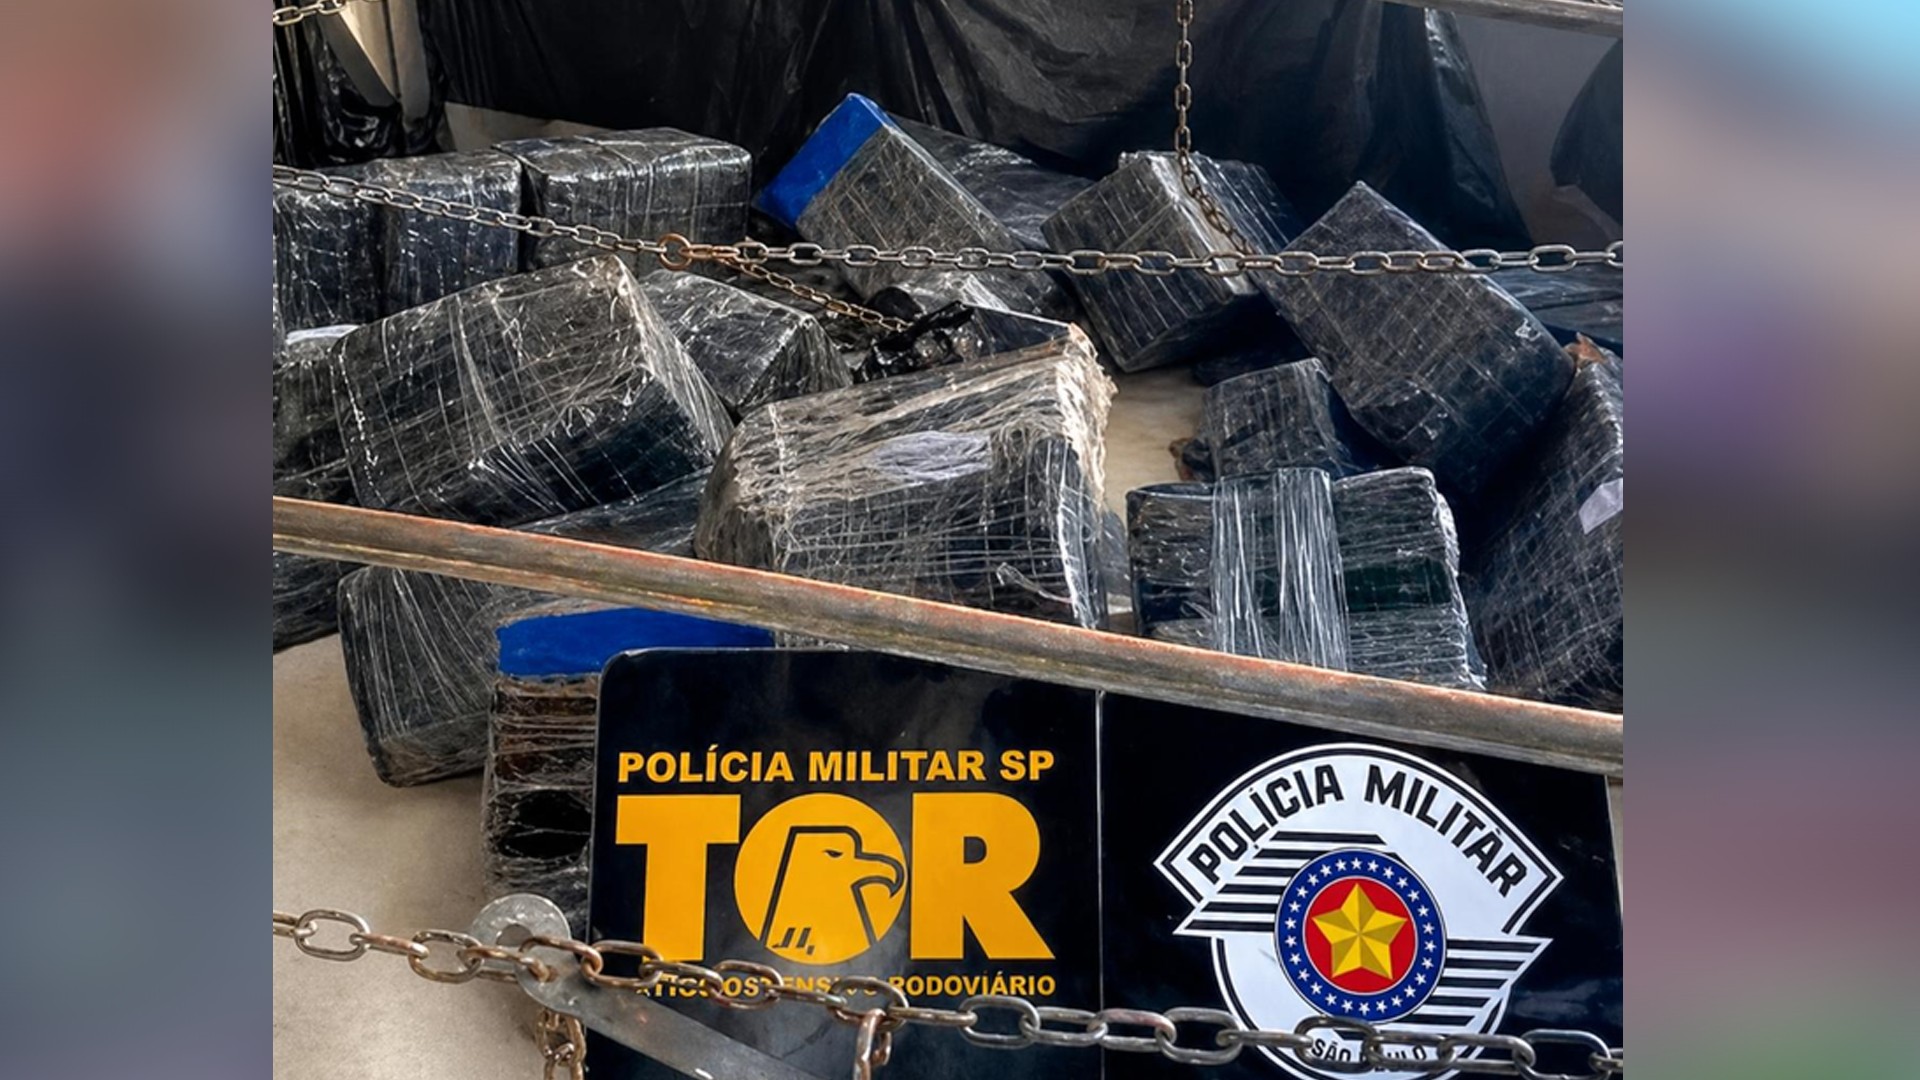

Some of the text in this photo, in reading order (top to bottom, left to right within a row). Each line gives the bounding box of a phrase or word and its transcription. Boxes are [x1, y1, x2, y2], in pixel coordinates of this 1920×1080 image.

[617, 744, 1055, 783] POLÍCIA MILITAR SP
[1187, 763, 1528, 898] POLÍCIA MILITAR
[615, 792, 1056, 964] TOR
[888, 971, 1056, 996] RODOVIÁRIO
